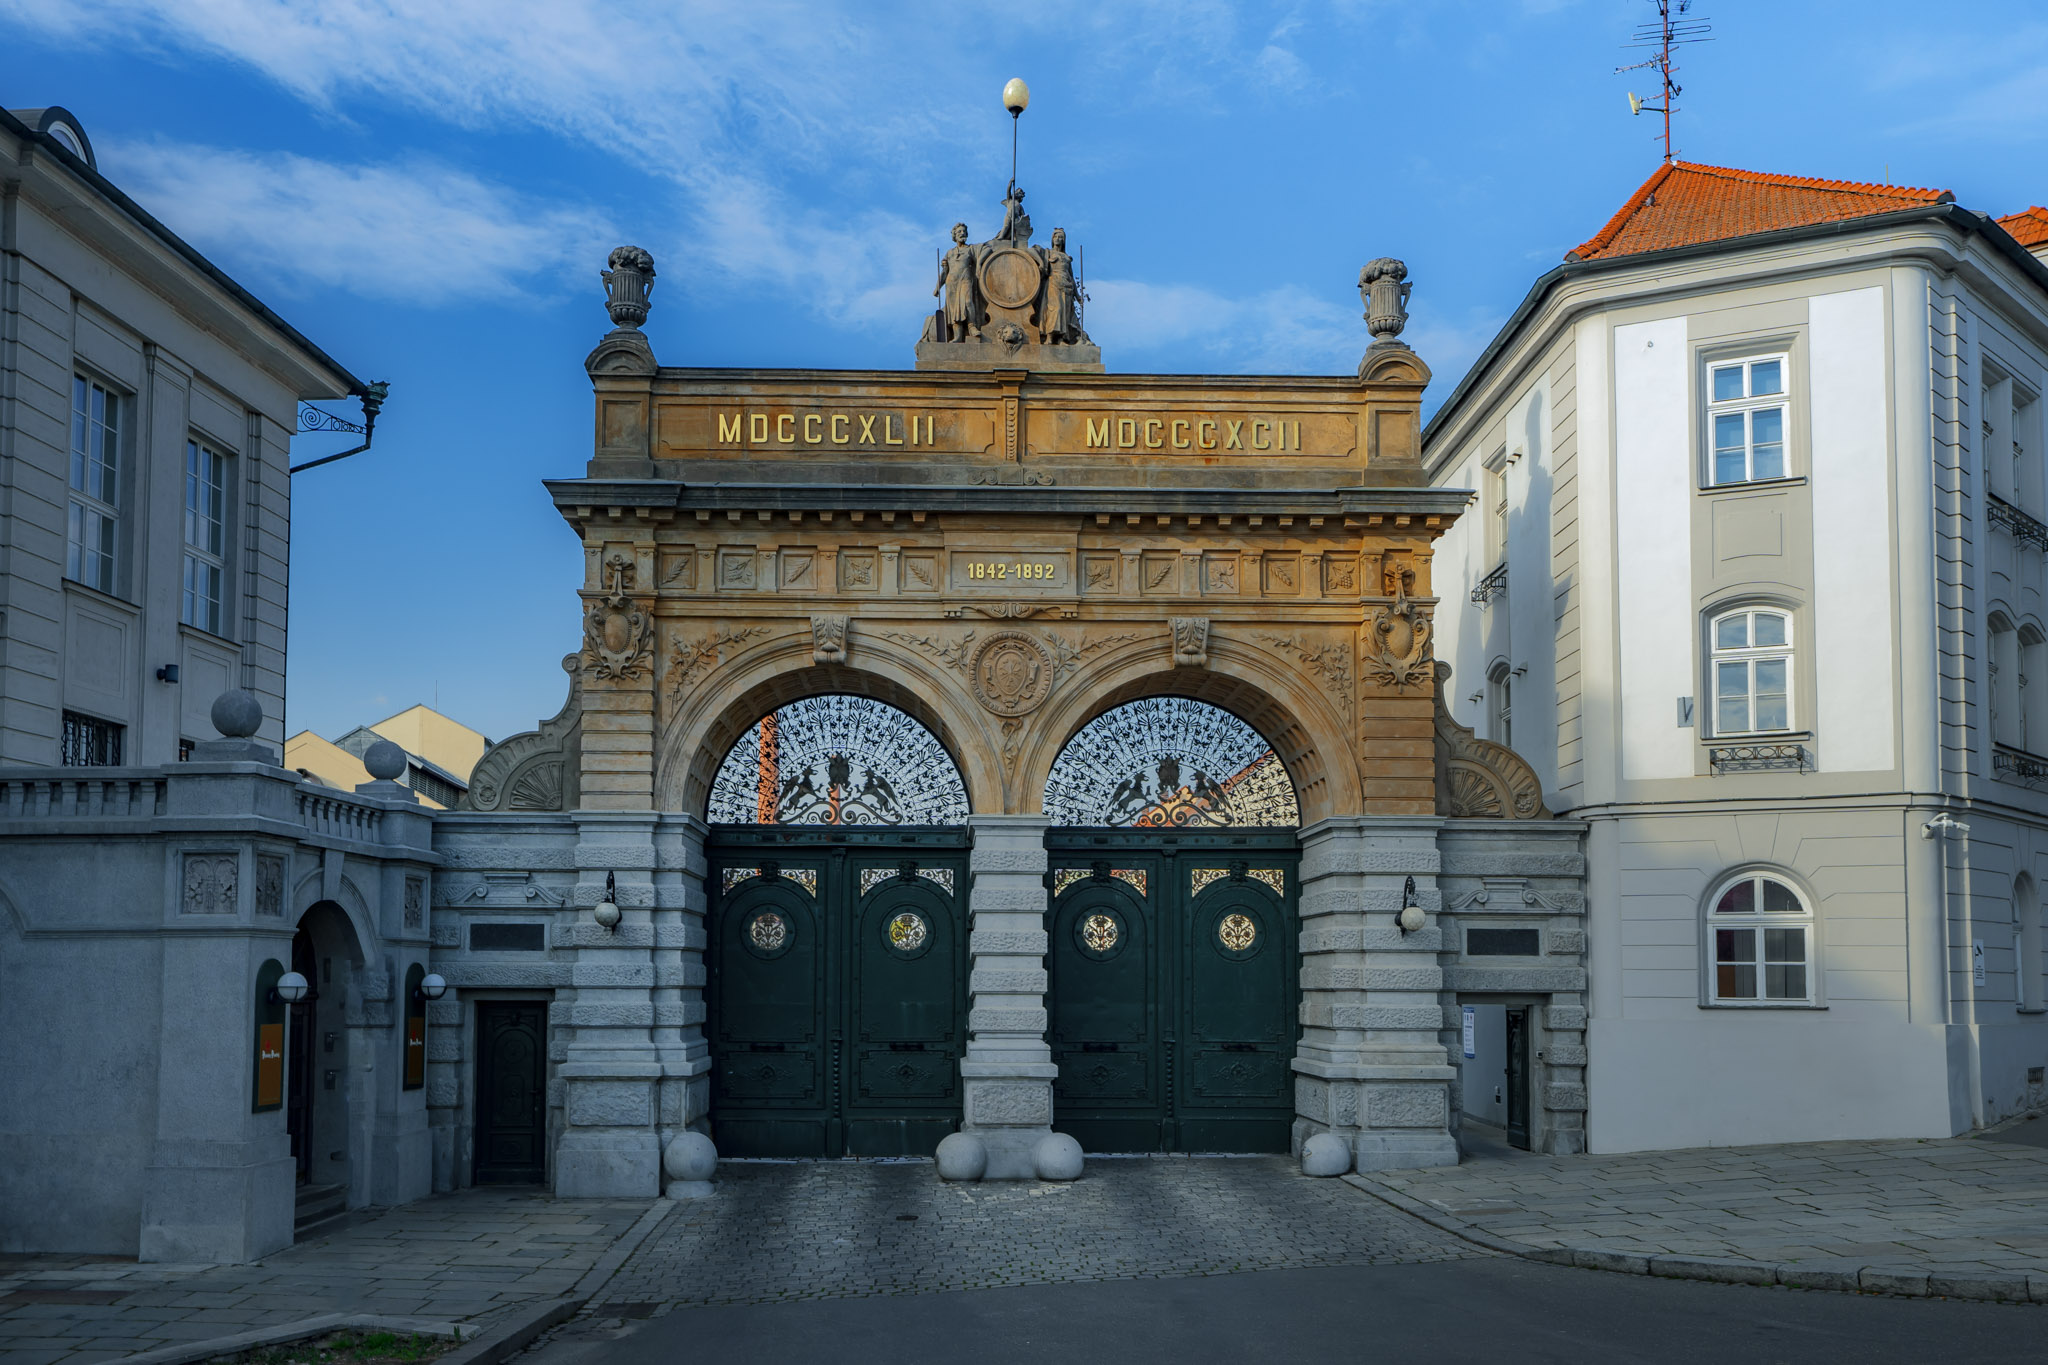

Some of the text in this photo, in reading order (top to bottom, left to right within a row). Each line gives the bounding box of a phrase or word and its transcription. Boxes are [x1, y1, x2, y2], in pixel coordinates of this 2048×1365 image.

[718, 412, 935, 446] MDCCCXLII
[1086, 417, 1300, 450] MDCCCXCII
[967, 562, 1055, 579] 1842-1892
